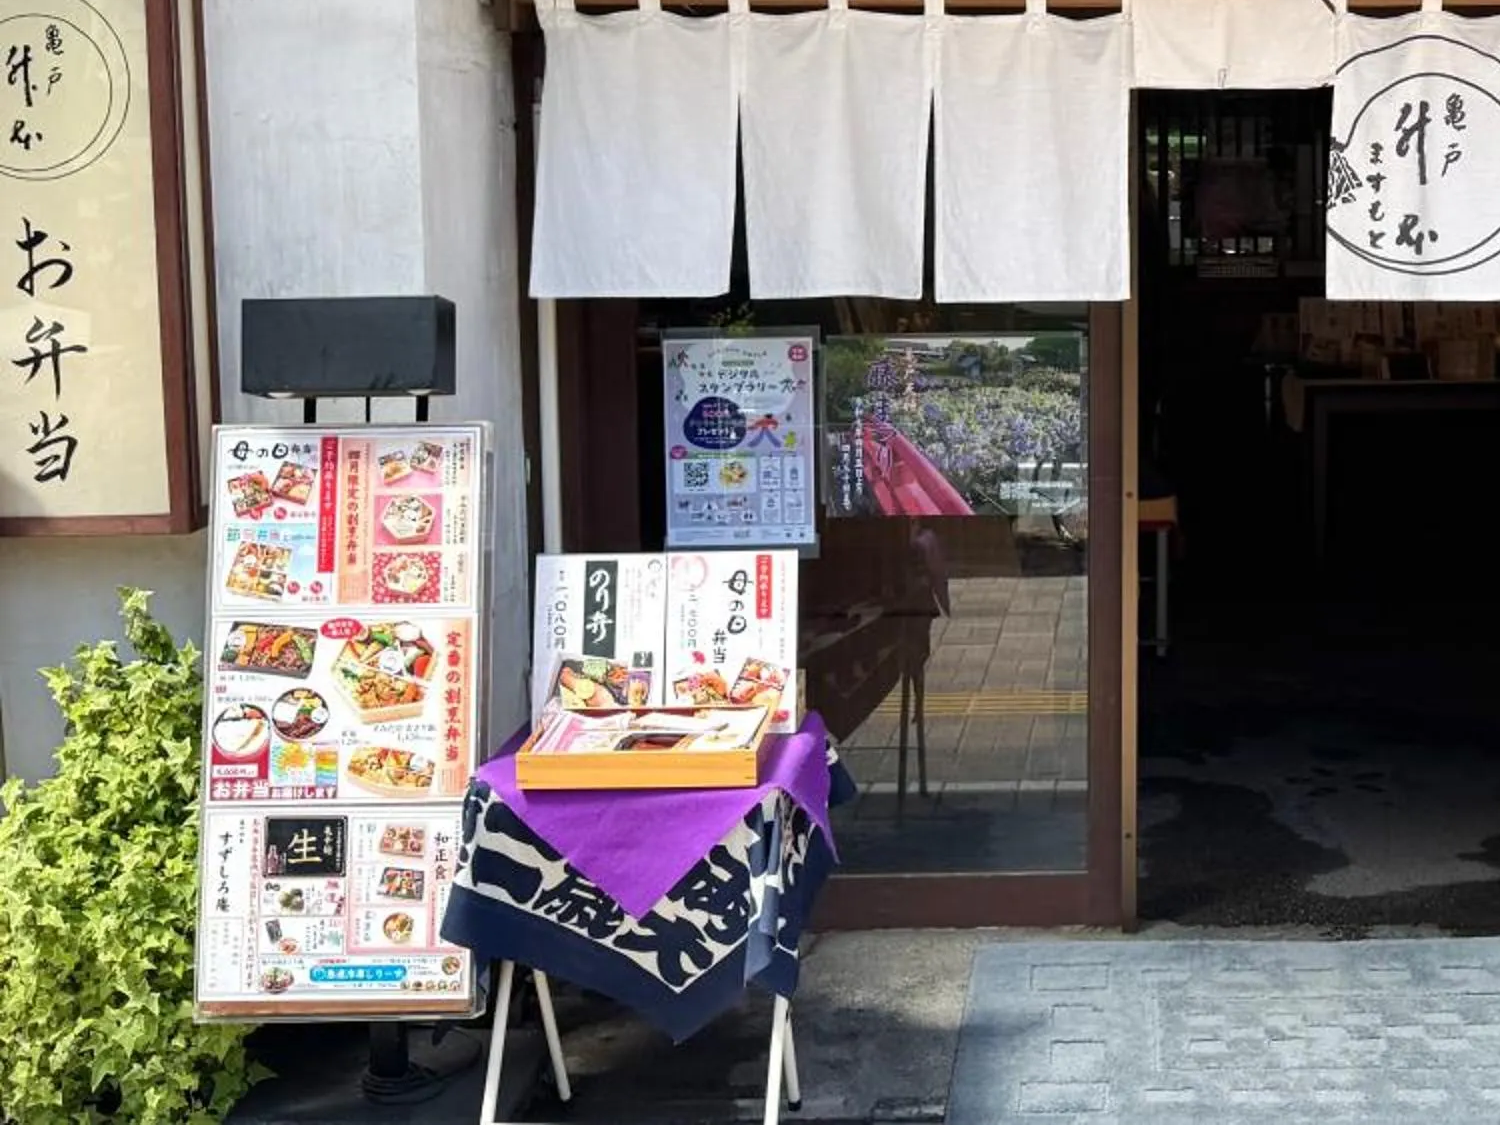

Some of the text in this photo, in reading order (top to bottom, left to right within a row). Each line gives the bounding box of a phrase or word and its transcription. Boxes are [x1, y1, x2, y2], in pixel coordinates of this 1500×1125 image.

[43, 24, 64, 95] 亀戸
[1441, 93, 1466, 177] 亀戸
[1366, 142, 1386, 249] ますもと
[12, 217, 87, 483] お弁当
[700, 381, 777, 393] スタンプラリー
[586, 568, 614, 645] のり弁
[722, 569, 754, 635] 母の日
[287, 828, 323, 864] 生
